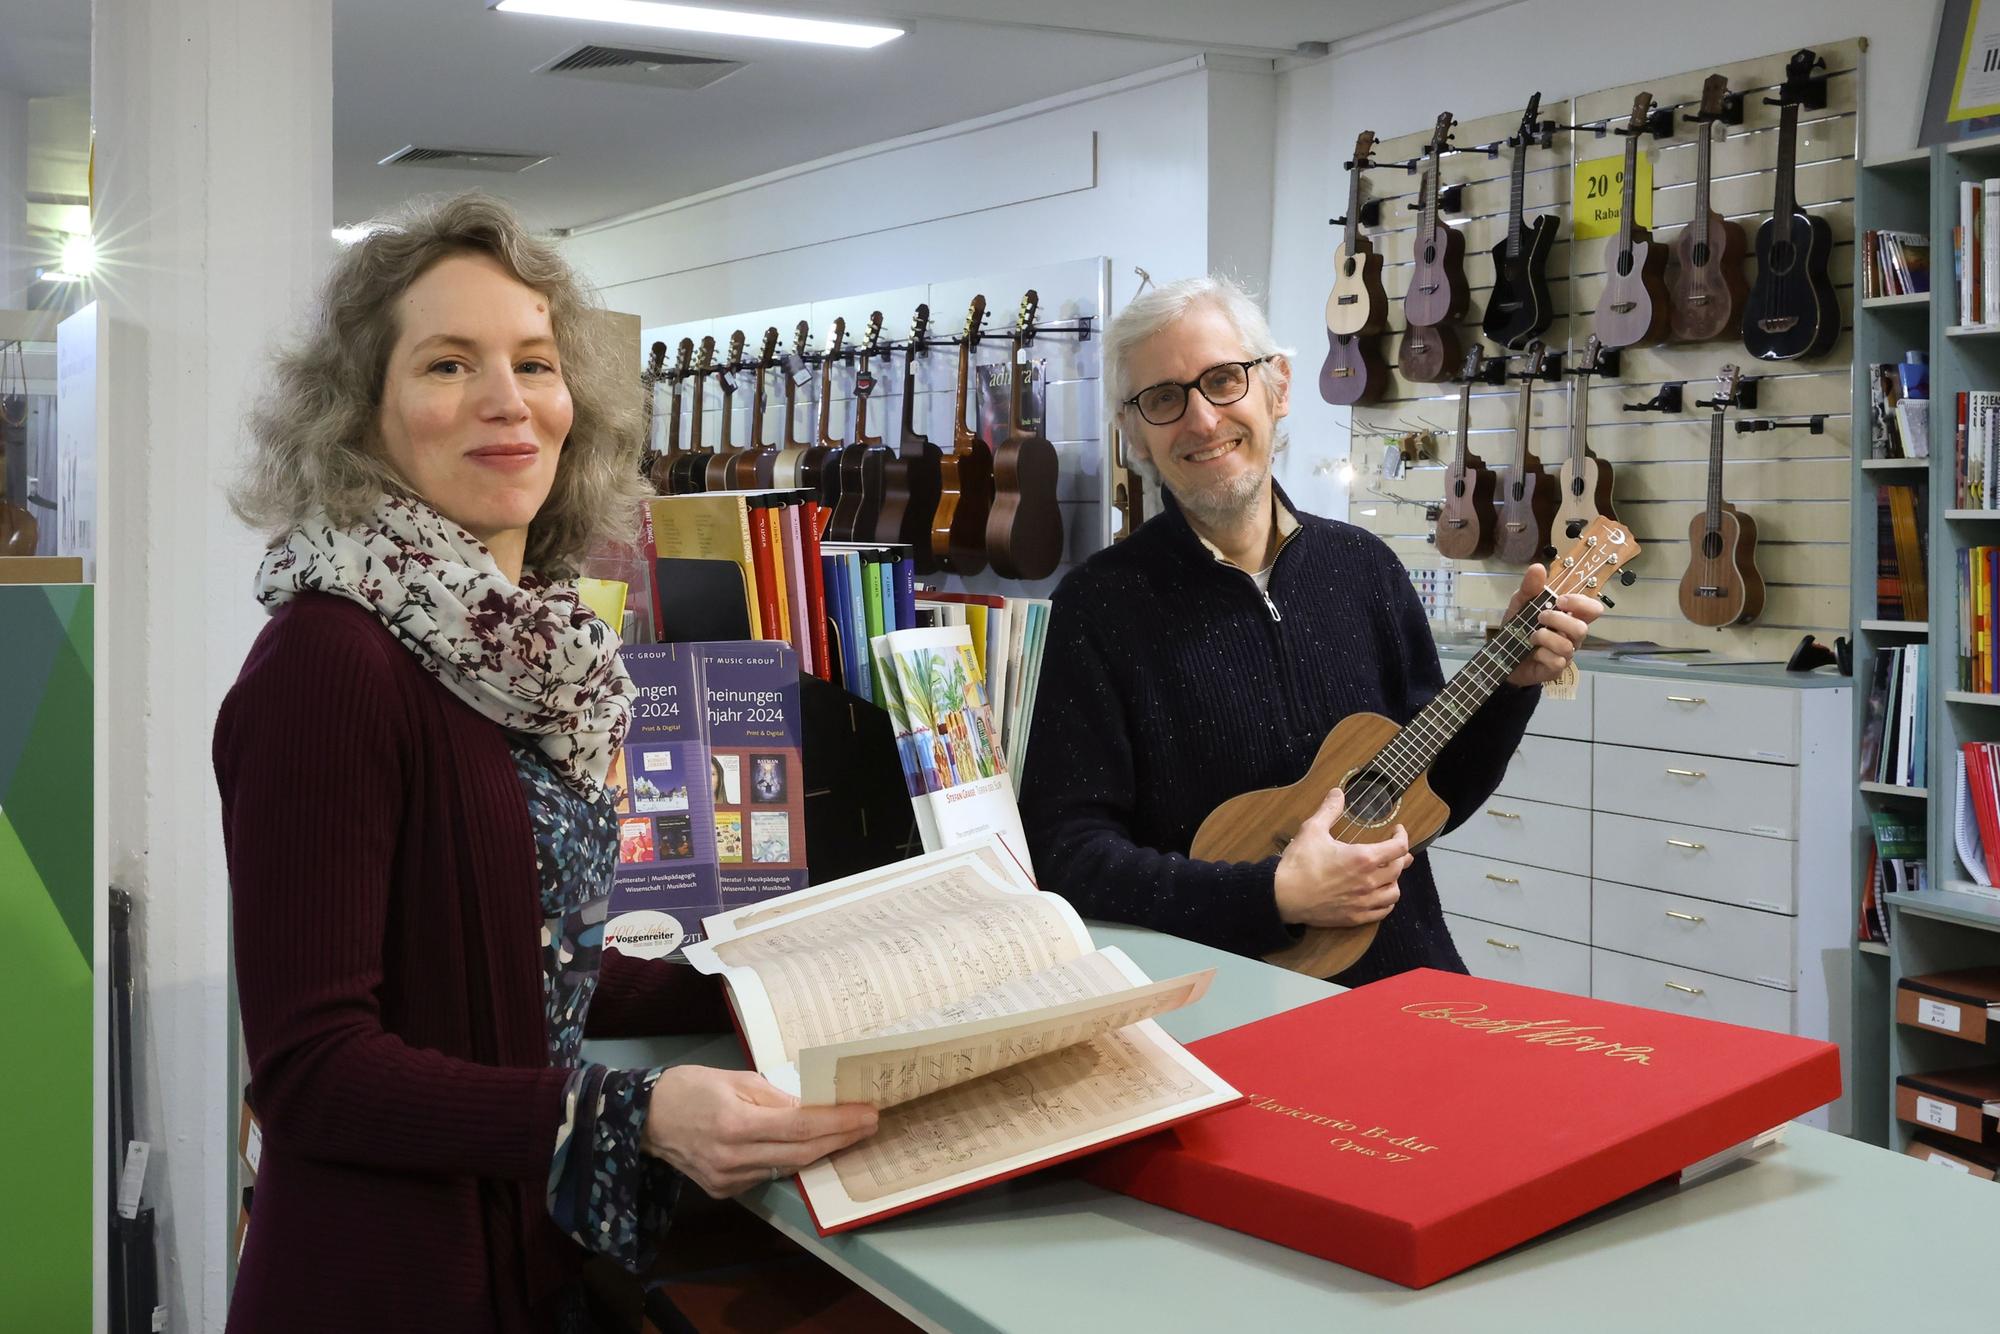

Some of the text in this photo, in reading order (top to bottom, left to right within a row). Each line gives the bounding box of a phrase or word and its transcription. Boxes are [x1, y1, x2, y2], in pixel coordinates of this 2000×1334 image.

[1587, 174, 1608, 199] 20
[1594, 207, 1622, 221] Raba
[646, 523, 654, 544] SONGS
[620, 651, 667, 660] SIC GROUP
[717, 657, 743, 665] MUSIC
[707, 687, 783, 706] heinungen
[641, 702, 680, 718] 2024
[707, 706, 784, 726] hjahr 2024
[614, 872, 696, 885] pielliteratur Musikpädagogik
[747, 875, 790, 883] Musikpädagogik
[625, 881, 697, 893] Wissenschaft Musikbuch
[615, 931, 675, 944] Voggenreiter
[1360, 1126, 1439, 1153] B-dur
[1329, 1137, 1413, 1163] Opus 97
